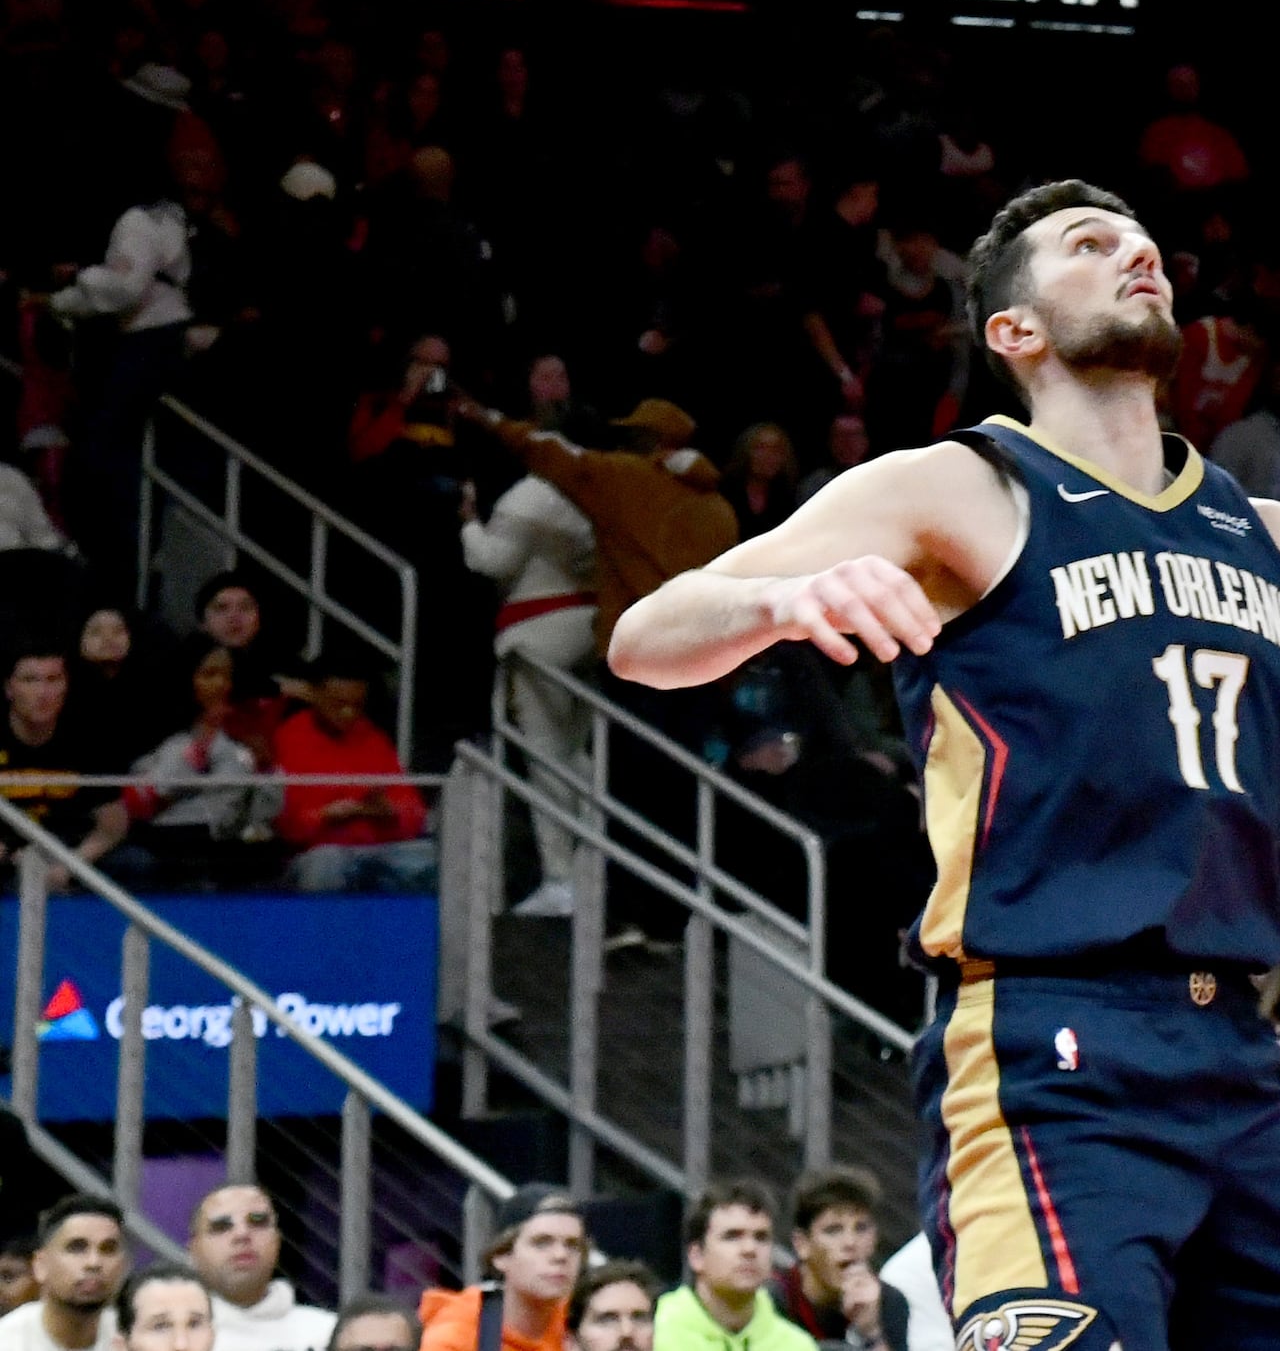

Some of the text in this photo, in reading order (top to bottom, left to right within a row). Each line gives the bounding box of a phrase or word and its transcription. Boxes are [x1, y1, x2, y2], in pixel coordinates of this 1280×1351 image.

[1049, 550, 1155, 640] NEW
[1152, 644, 1248, 794] 17
[276, 992, 400, 1038] Power
